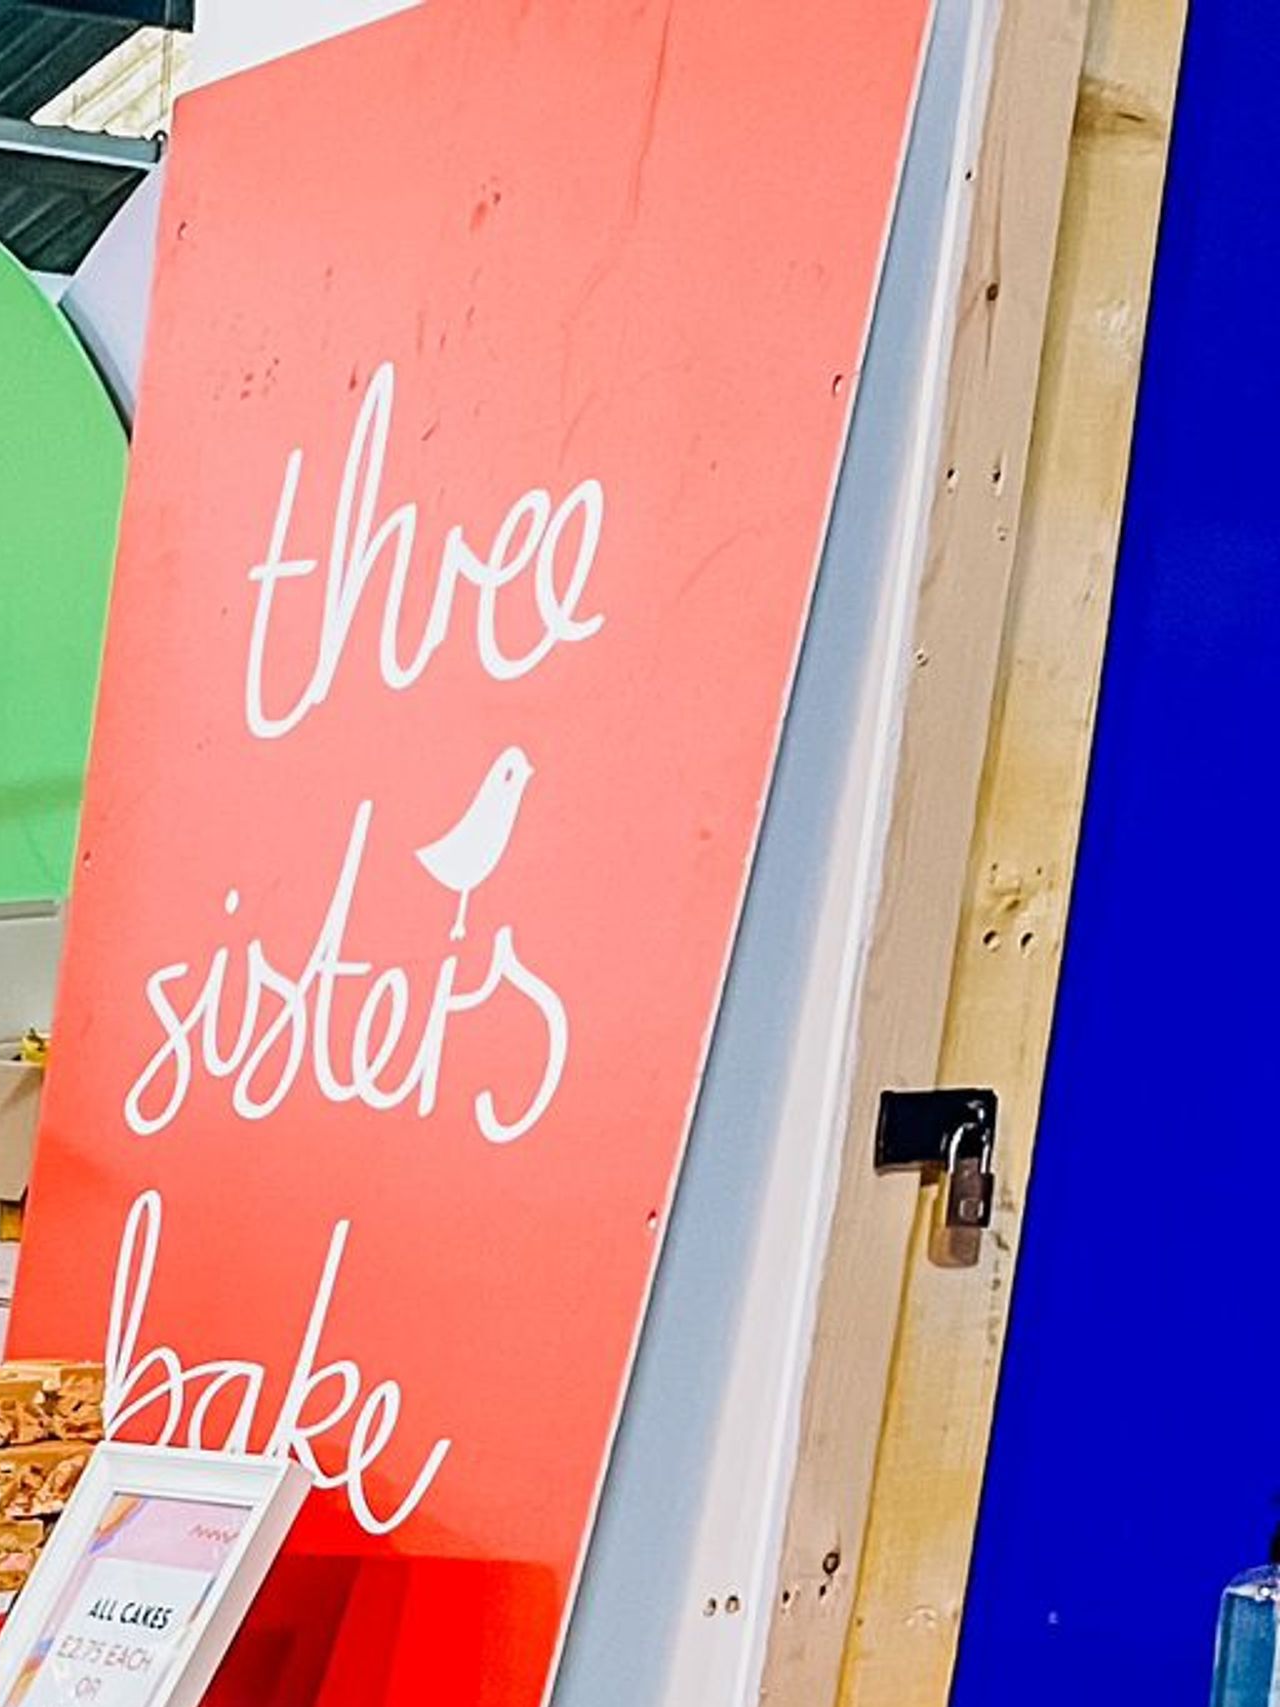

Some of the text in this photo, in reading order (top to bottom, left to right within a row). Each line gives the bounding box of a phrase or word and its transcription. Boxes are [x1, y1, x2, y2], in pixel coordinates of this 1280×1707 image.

[241, 361, 605, 738] three
[124, 799, 571, 1144] sisters
[102, 1189, 452, 1535] bake
[88, 1598, 172, 1630] ALL CAKES
